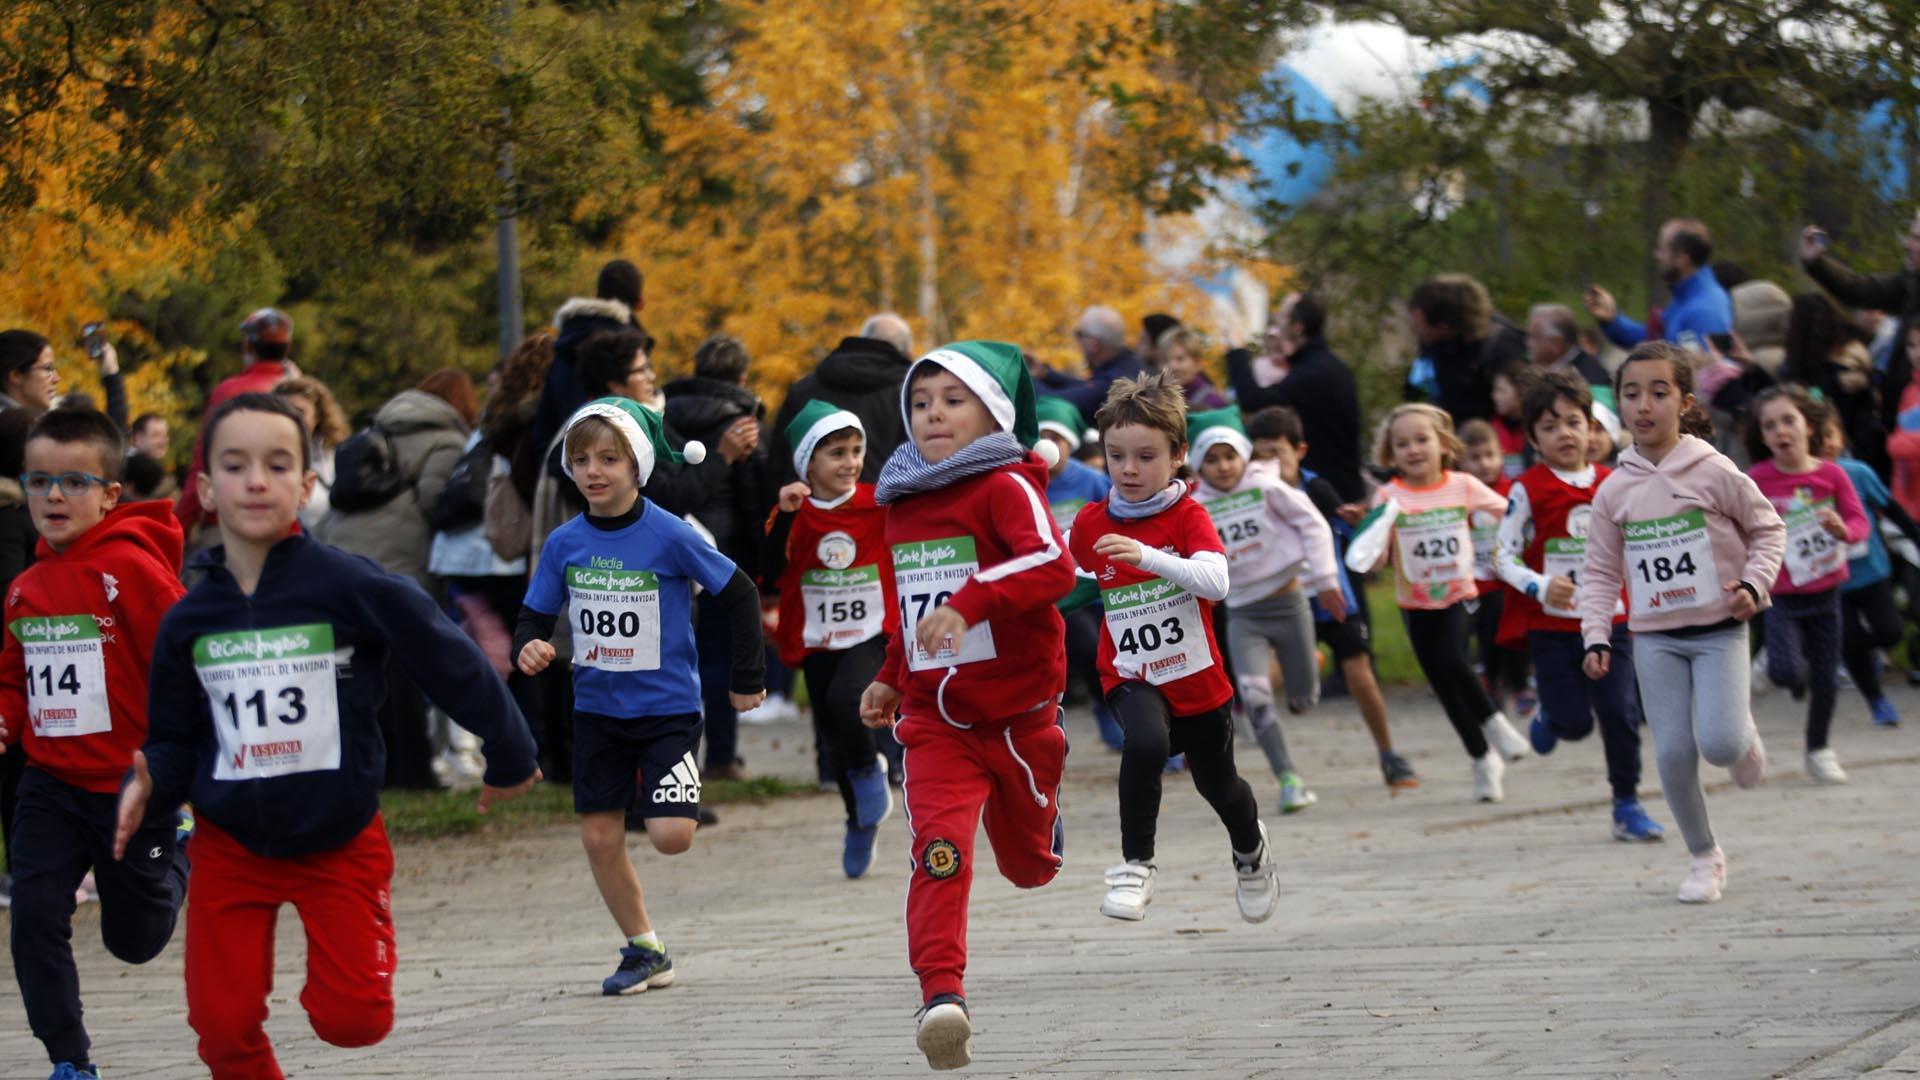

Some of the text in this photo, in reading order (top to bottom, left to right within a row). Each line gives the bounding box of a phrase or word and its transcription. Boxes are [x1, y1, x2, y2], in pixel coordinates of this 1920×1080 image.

[1413, 536, 1460, 558] 420
[591, 555, 624, 569] Media
[1637, 551, 1697, 583] 184
[584, 572, 607, 586] Corte
[607, 570, 644, 590] Inglés
[907, 572, 934, 584] INFANTIL
[944, 567, 975, 579] NAVIDAD
[593, 593, 619, 602] INFANTIL
[621, 594, 629, 603] DE
[630, 594, 656, 603] NAVIDAD
[1116, 590, 1139, 604] Corte
[1139, 581, 1176, 603] Inglés
[817, 600, 867, 624] 158
[1129, 605, 1158, 619] INFANTIL
[1158, 602, 1168, 612] DE
[1168, 592, 1193, 608] NAVIDAD
[580, 608, 640, 638] 080
[1118, 616, 1185, 655] 403
[67, 643, 98, 653] NAVIDAD
[26, 664, 82, 696] 114
[238, 664, 276, 679] INFANTIL
[279, 663, 290, 675] DE
[293, 659, 330, 673] NAVIDAD
[224, 686, 308, 730] 113
[652, 783, 700, 804] adid
[931, 850, 949, 868] B
